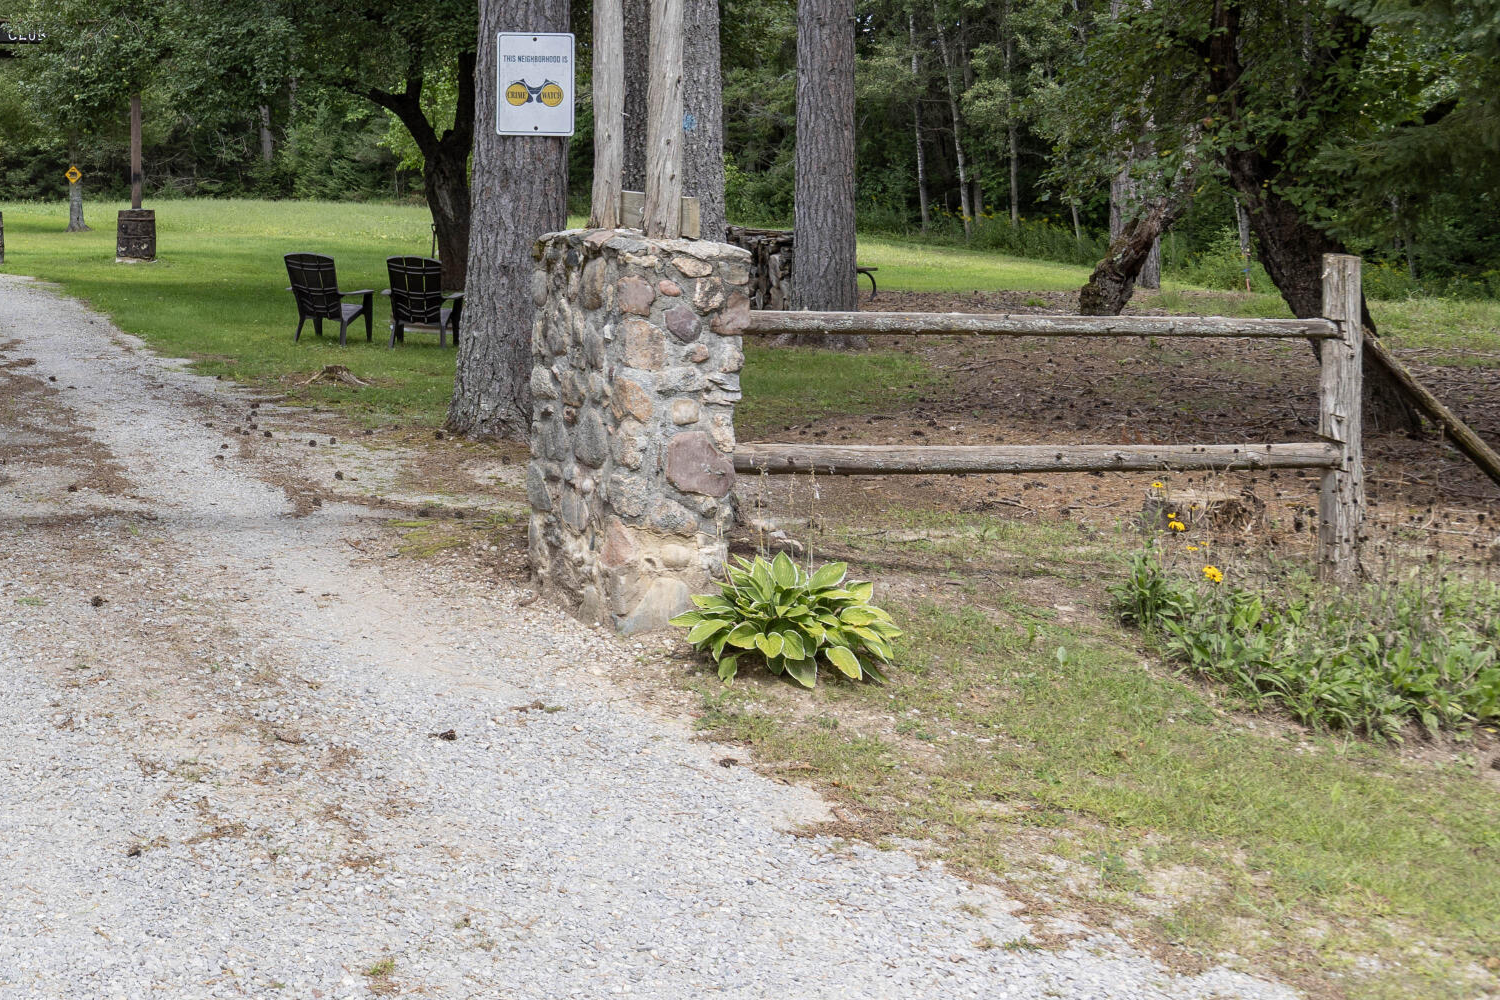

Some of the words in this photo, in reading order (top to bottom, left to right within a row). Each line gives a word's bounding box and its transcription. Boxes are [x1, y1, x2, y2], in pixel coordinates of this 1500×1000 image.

[503, 55, 516, 63] THIS
[517, 55, 560, 63] NEIGHBORHOOD
[561, 55, 569, 63] IS
[507, 91, 526, 99] CRIME
[542, 91, 562, 99] WATCH
